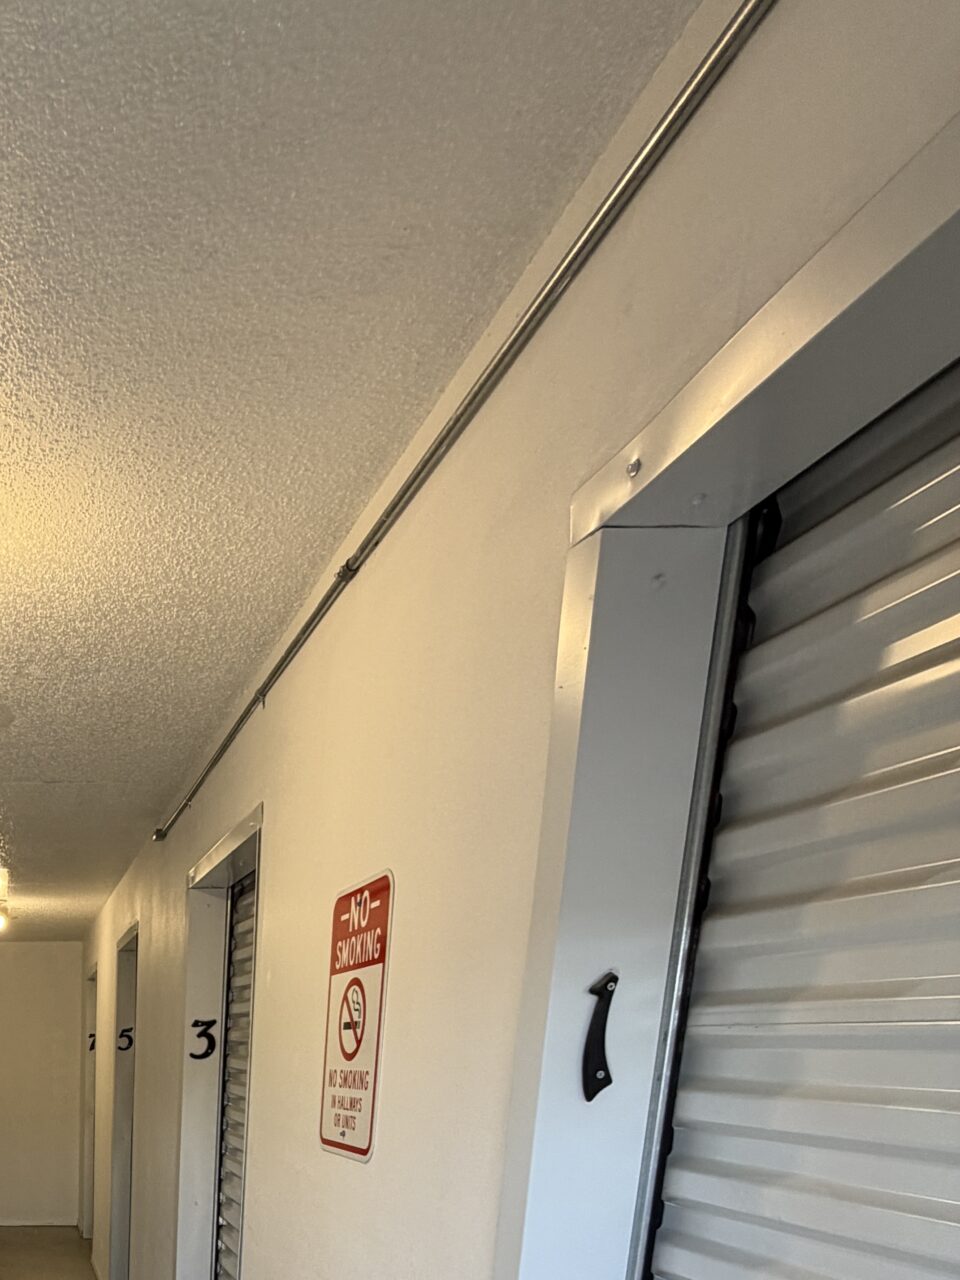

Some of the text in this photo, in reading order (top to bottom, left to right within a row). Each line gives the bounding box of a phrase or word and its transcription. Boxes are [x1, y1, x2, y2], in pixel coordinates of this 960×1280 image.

[335, 927, 382, 970] SMOKING
[117, 1027, 134, 1051] 5
[189, 1019, 217, 1060] 3
[582, 971, 619, 1102] 1
[328, 1069, 369, 1091] NO SMOKING
[331, 1094, 363, 1113] IN HALLWAYS
[333, 1112, 356, 1131] OR UNITS
